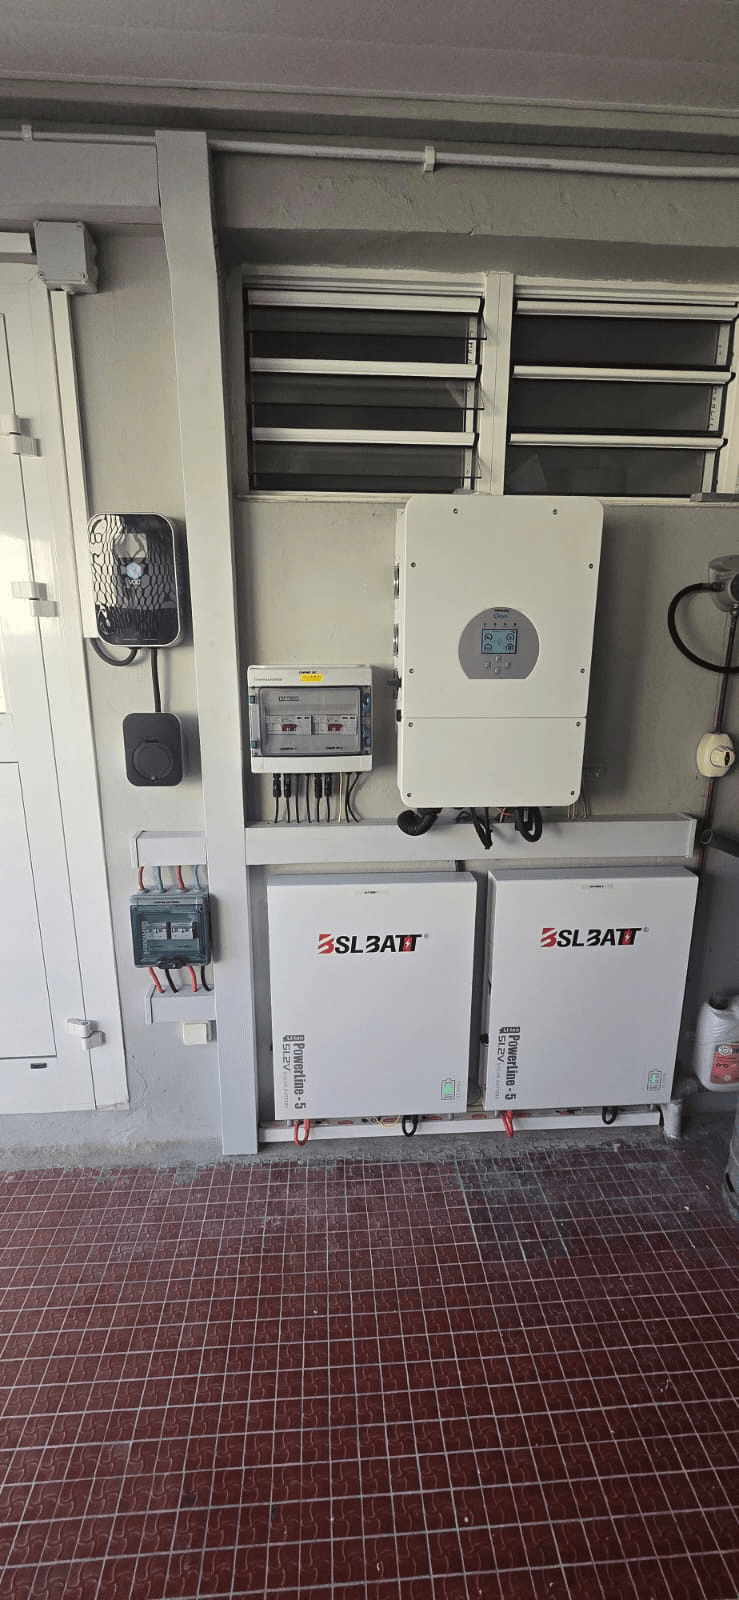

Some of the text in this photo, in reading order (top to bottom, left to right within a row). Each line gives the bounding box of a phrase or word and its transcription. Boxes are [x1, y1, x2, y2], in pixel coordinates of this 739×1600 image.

[317, 933, 423, 954] BSLBATT
[540, 927, 643, 948] BSLBATT
[282, 1043, 291, 1071] 51.2V
[498, 1035, 506, 1062] 51.2V
[506, 1035, 520, 1086] PowerLine
[293, 1042, 306, 1095] PowerLine
